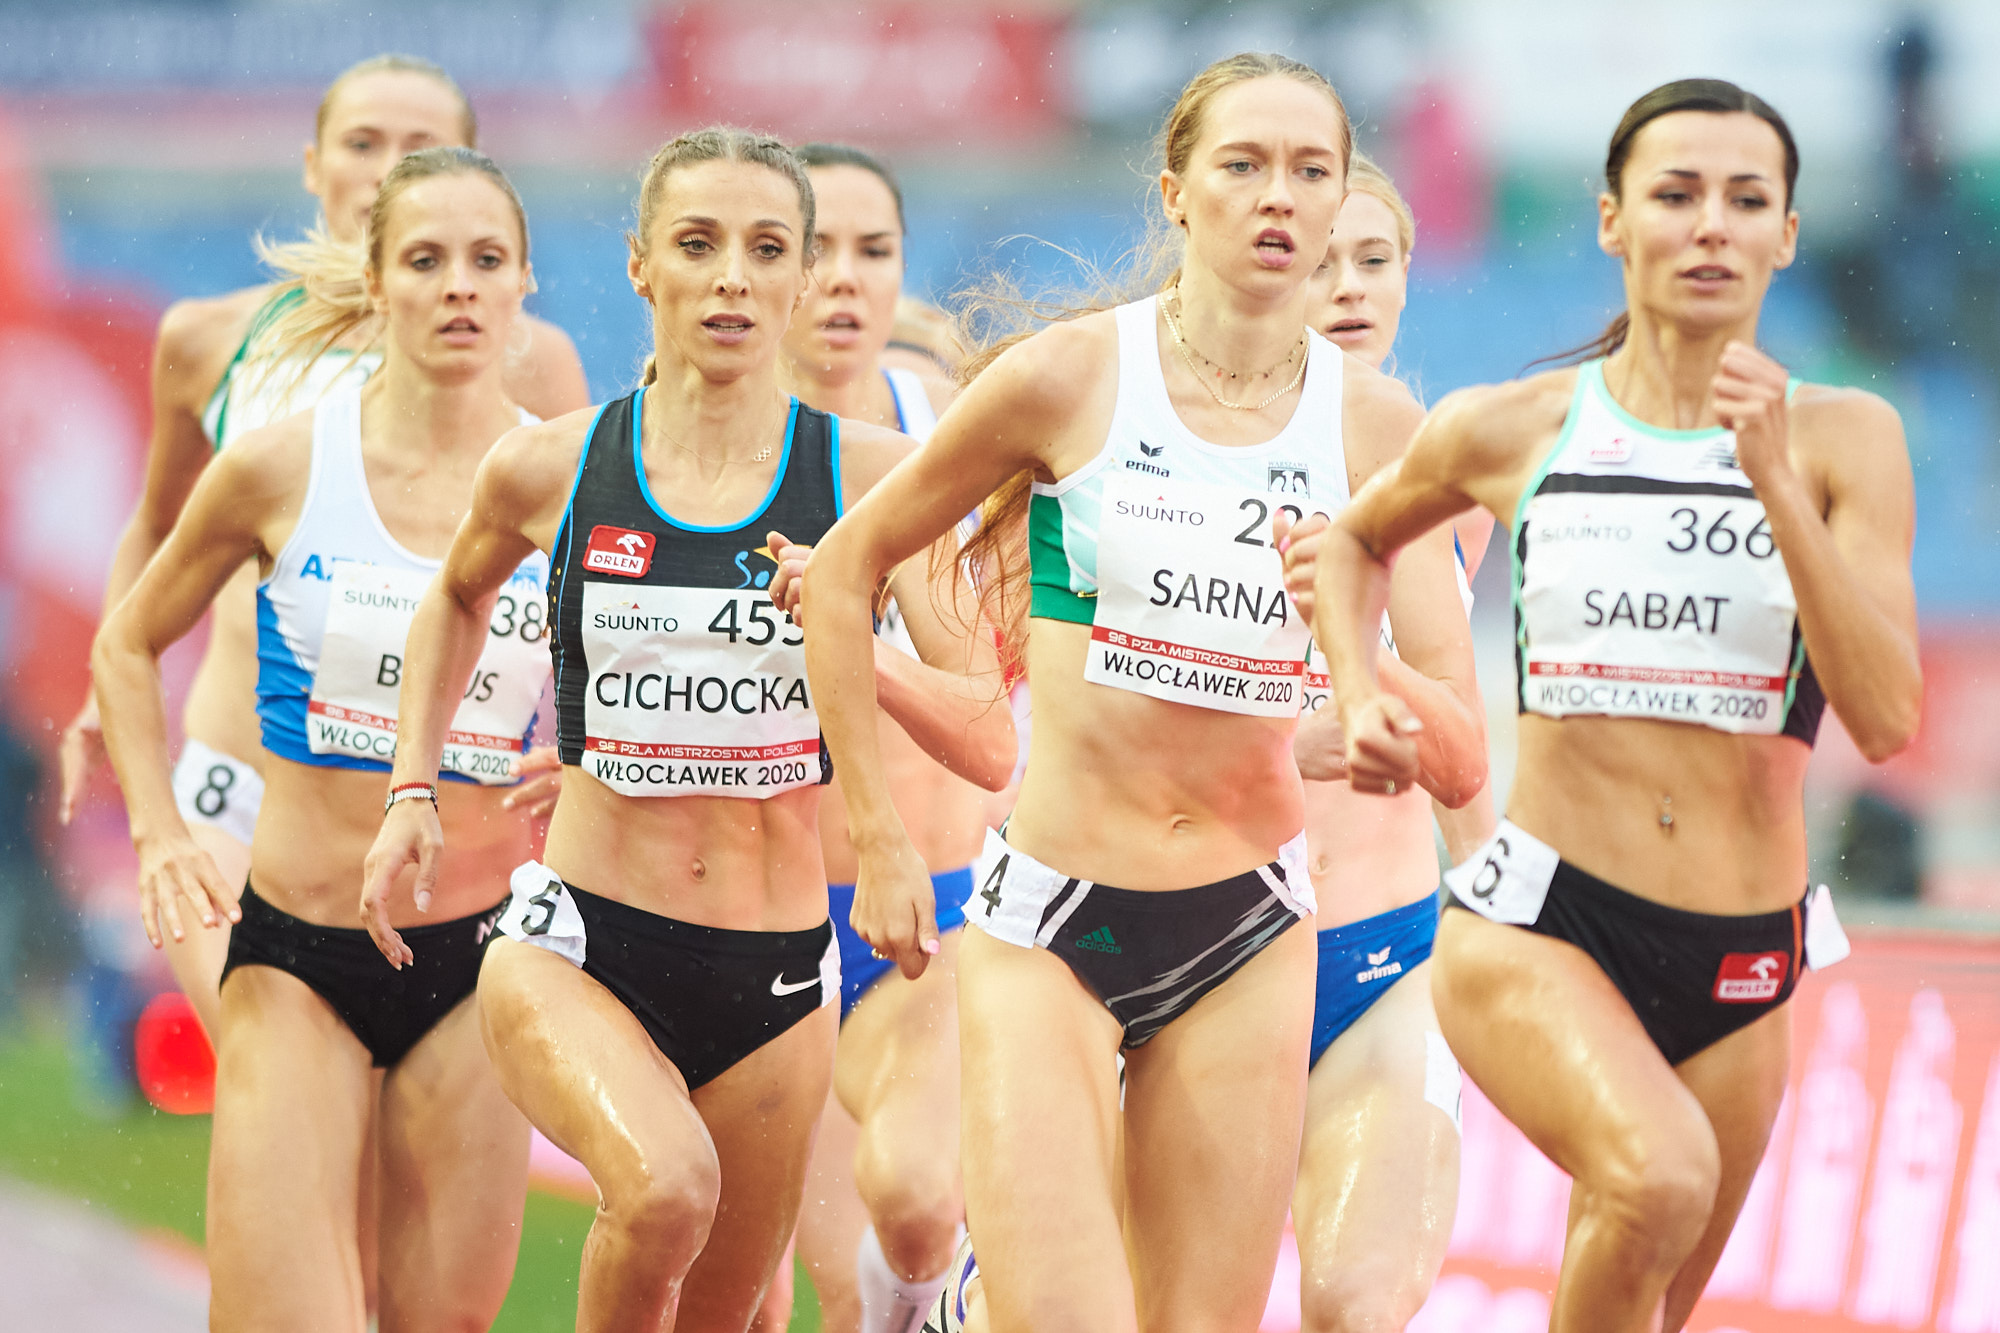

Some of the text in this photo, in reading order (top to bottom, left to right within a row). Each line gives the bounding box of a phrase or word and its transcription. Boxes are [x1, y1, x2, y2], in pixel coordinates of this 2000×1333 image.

[1125, 459, 1170, 478] erima
[1116, 500, 1205, 526] SUUNTO
[1540, 525, 1632, 543] SUUNTO
[1666, 508, 1776, 559] 366
[593, 554, 639, 569] ORLEN
[1149, 568, 1288, 628] SARNA
[1584, 589, 1730, 634] SABAT
[594, 614, 679, 632] SUUNTO
[1108, 631, 1294, 674] 96. PZLA MISTRZOSTWA POLSKI
[1104, 650, 1251, 699] WŁOCŁAWEK
[1254, 681, 1293, 703] 2020
[595, 672, 810, 715] CICHOCKA
[1711, 693, 1768, 720] 2020
[471, 753, 511, 776] 2020
[620, 745, 654, 756] PZLA
[658, 746, 761, 760] MISTRZOSTWA
[763, 743, 804, 758] POLSKI
[596, 758, 807, 786] WŁOCŁAWEK 2020
[195, 764, 235, 817] 8
[980, 853, 1011, 918] 4
[521, 879, 562, 936] 5
[1075, 939, 1122, 954] adidas
[1356, 961, 1402, 983] erima
